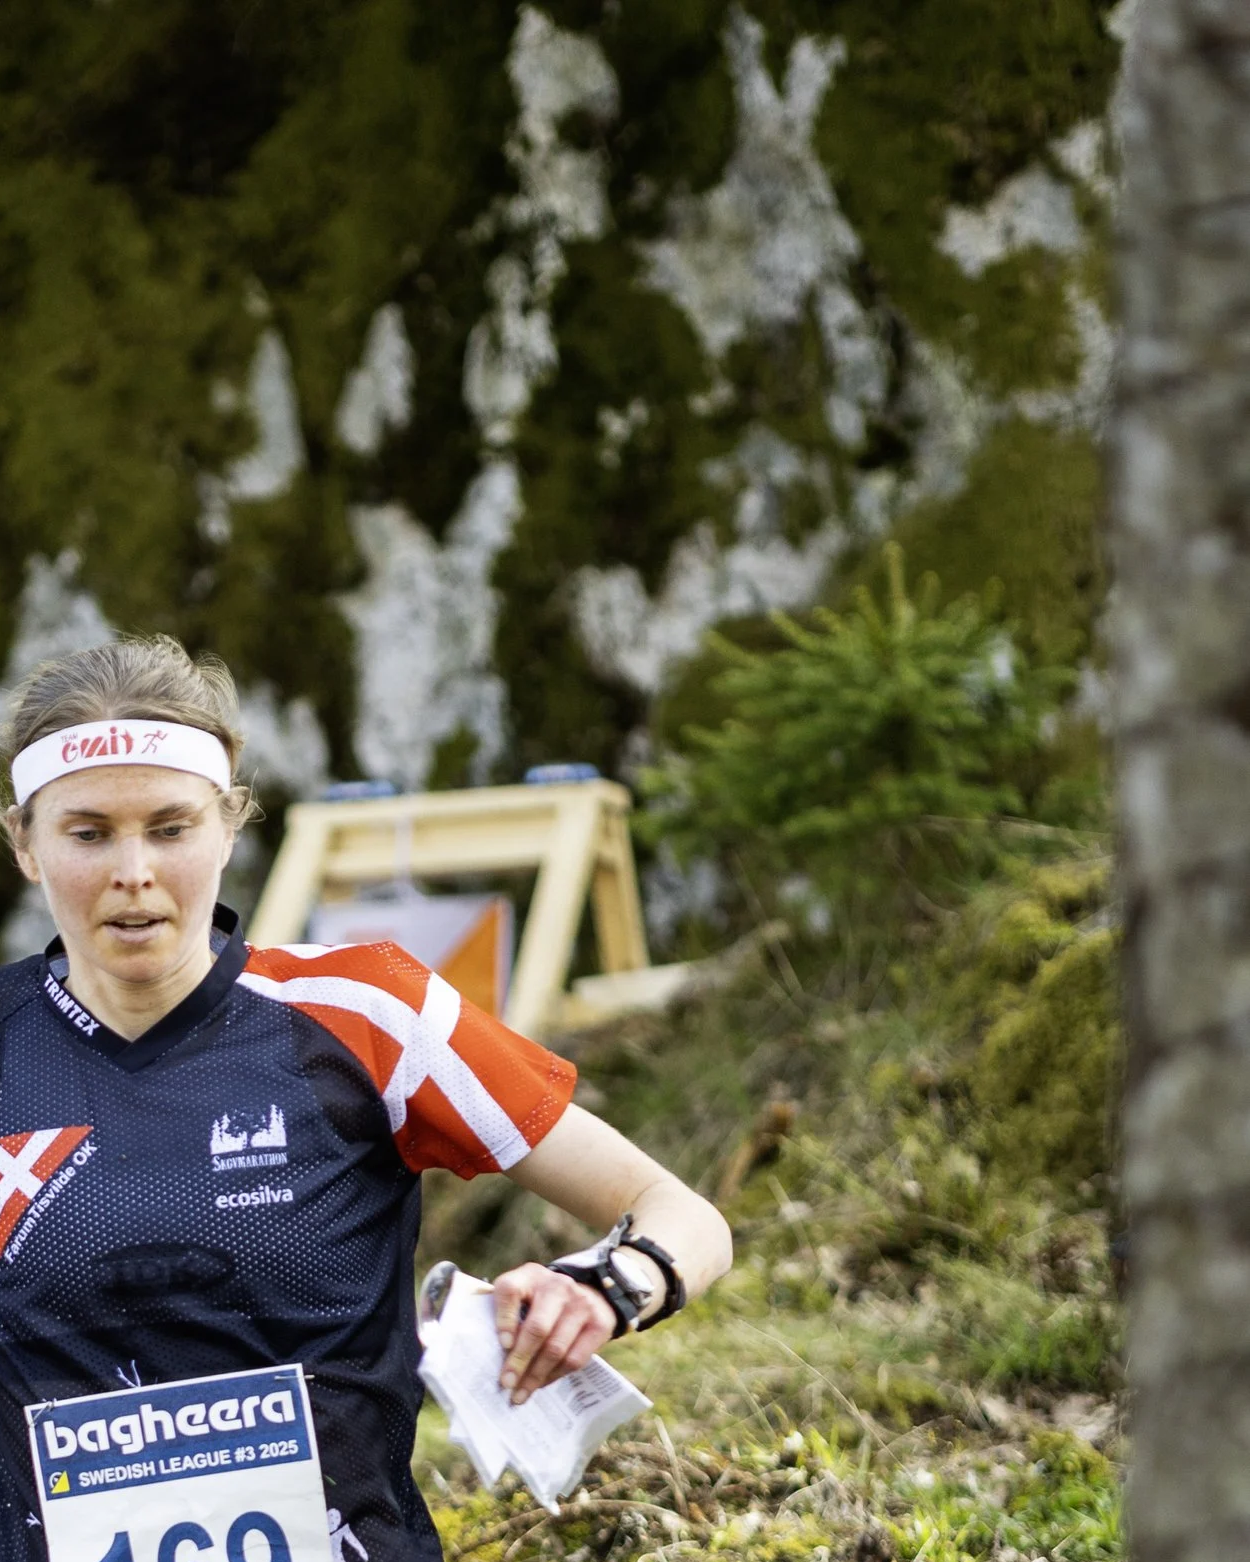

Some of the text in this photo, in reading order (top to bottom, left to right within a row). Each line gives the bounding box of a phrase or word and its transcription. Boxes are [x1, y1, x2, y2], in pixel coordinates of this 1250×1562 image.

[61, 732, 79, 743] TEAM
[62, 726, 134, 764] emit
[44, 973, 100, 1037] TRIMTEX
[72, 1139, 98, 1166] OK
[215, 1185, 294, 1208] ecosilva
[43, 1390, 296, 1460] bagheera
[78, 1440, 299, 1488] SWEDISH LEAGUE #3 2025
